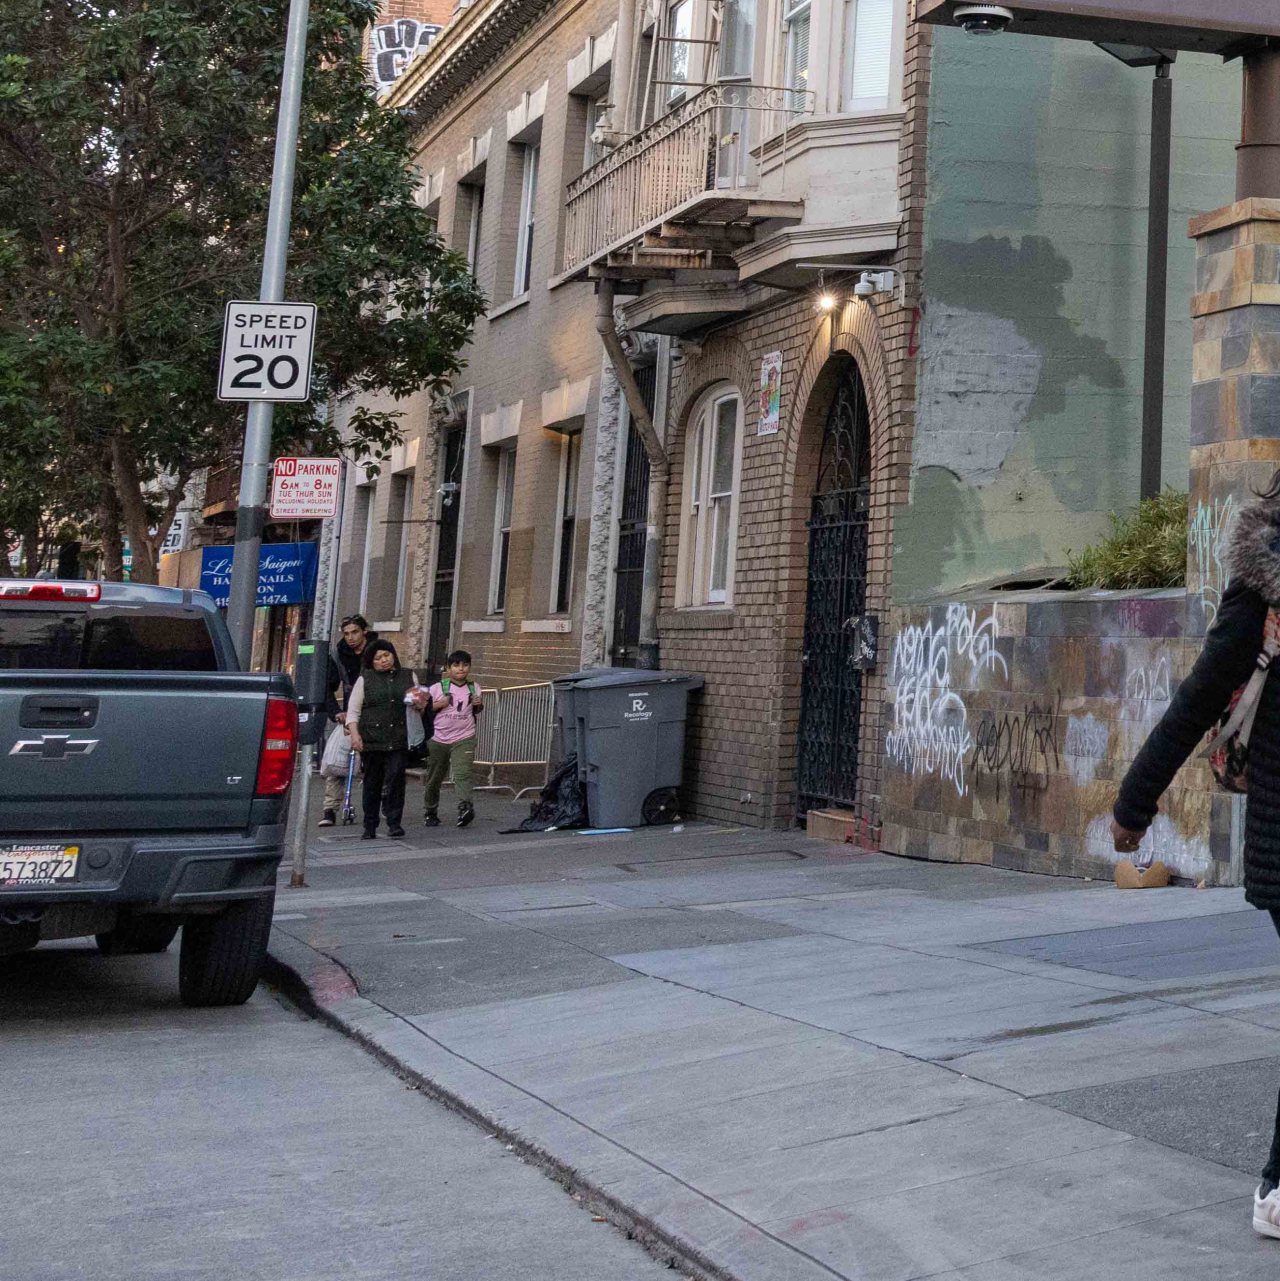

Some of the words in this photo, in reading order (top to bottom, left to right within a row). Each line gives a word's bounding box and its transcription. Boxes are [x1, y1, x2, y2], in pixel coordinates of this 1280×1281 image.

[234, 313, 307, 329] SPEED
[240, 333, 297, 349] LIMIT
[230, 354, 299, 389] 20
[277, 460, 295, 475] NO
[297, 464, 338, 475] PARKING
[280, 479, 300, 490] 6AM
[314, 479, 333, 490] 8AM
[279, 490, 292, 498] TUE
[295, 490, 314, 498] THUR
[259, 555, 304, 573] Saigon
[259, 575, 295, 584] NAILS
[624, 711, 653, 719] Recology
[12, 844, 62, 852] Lancaster
[0, 860, 73, 879] 573872
